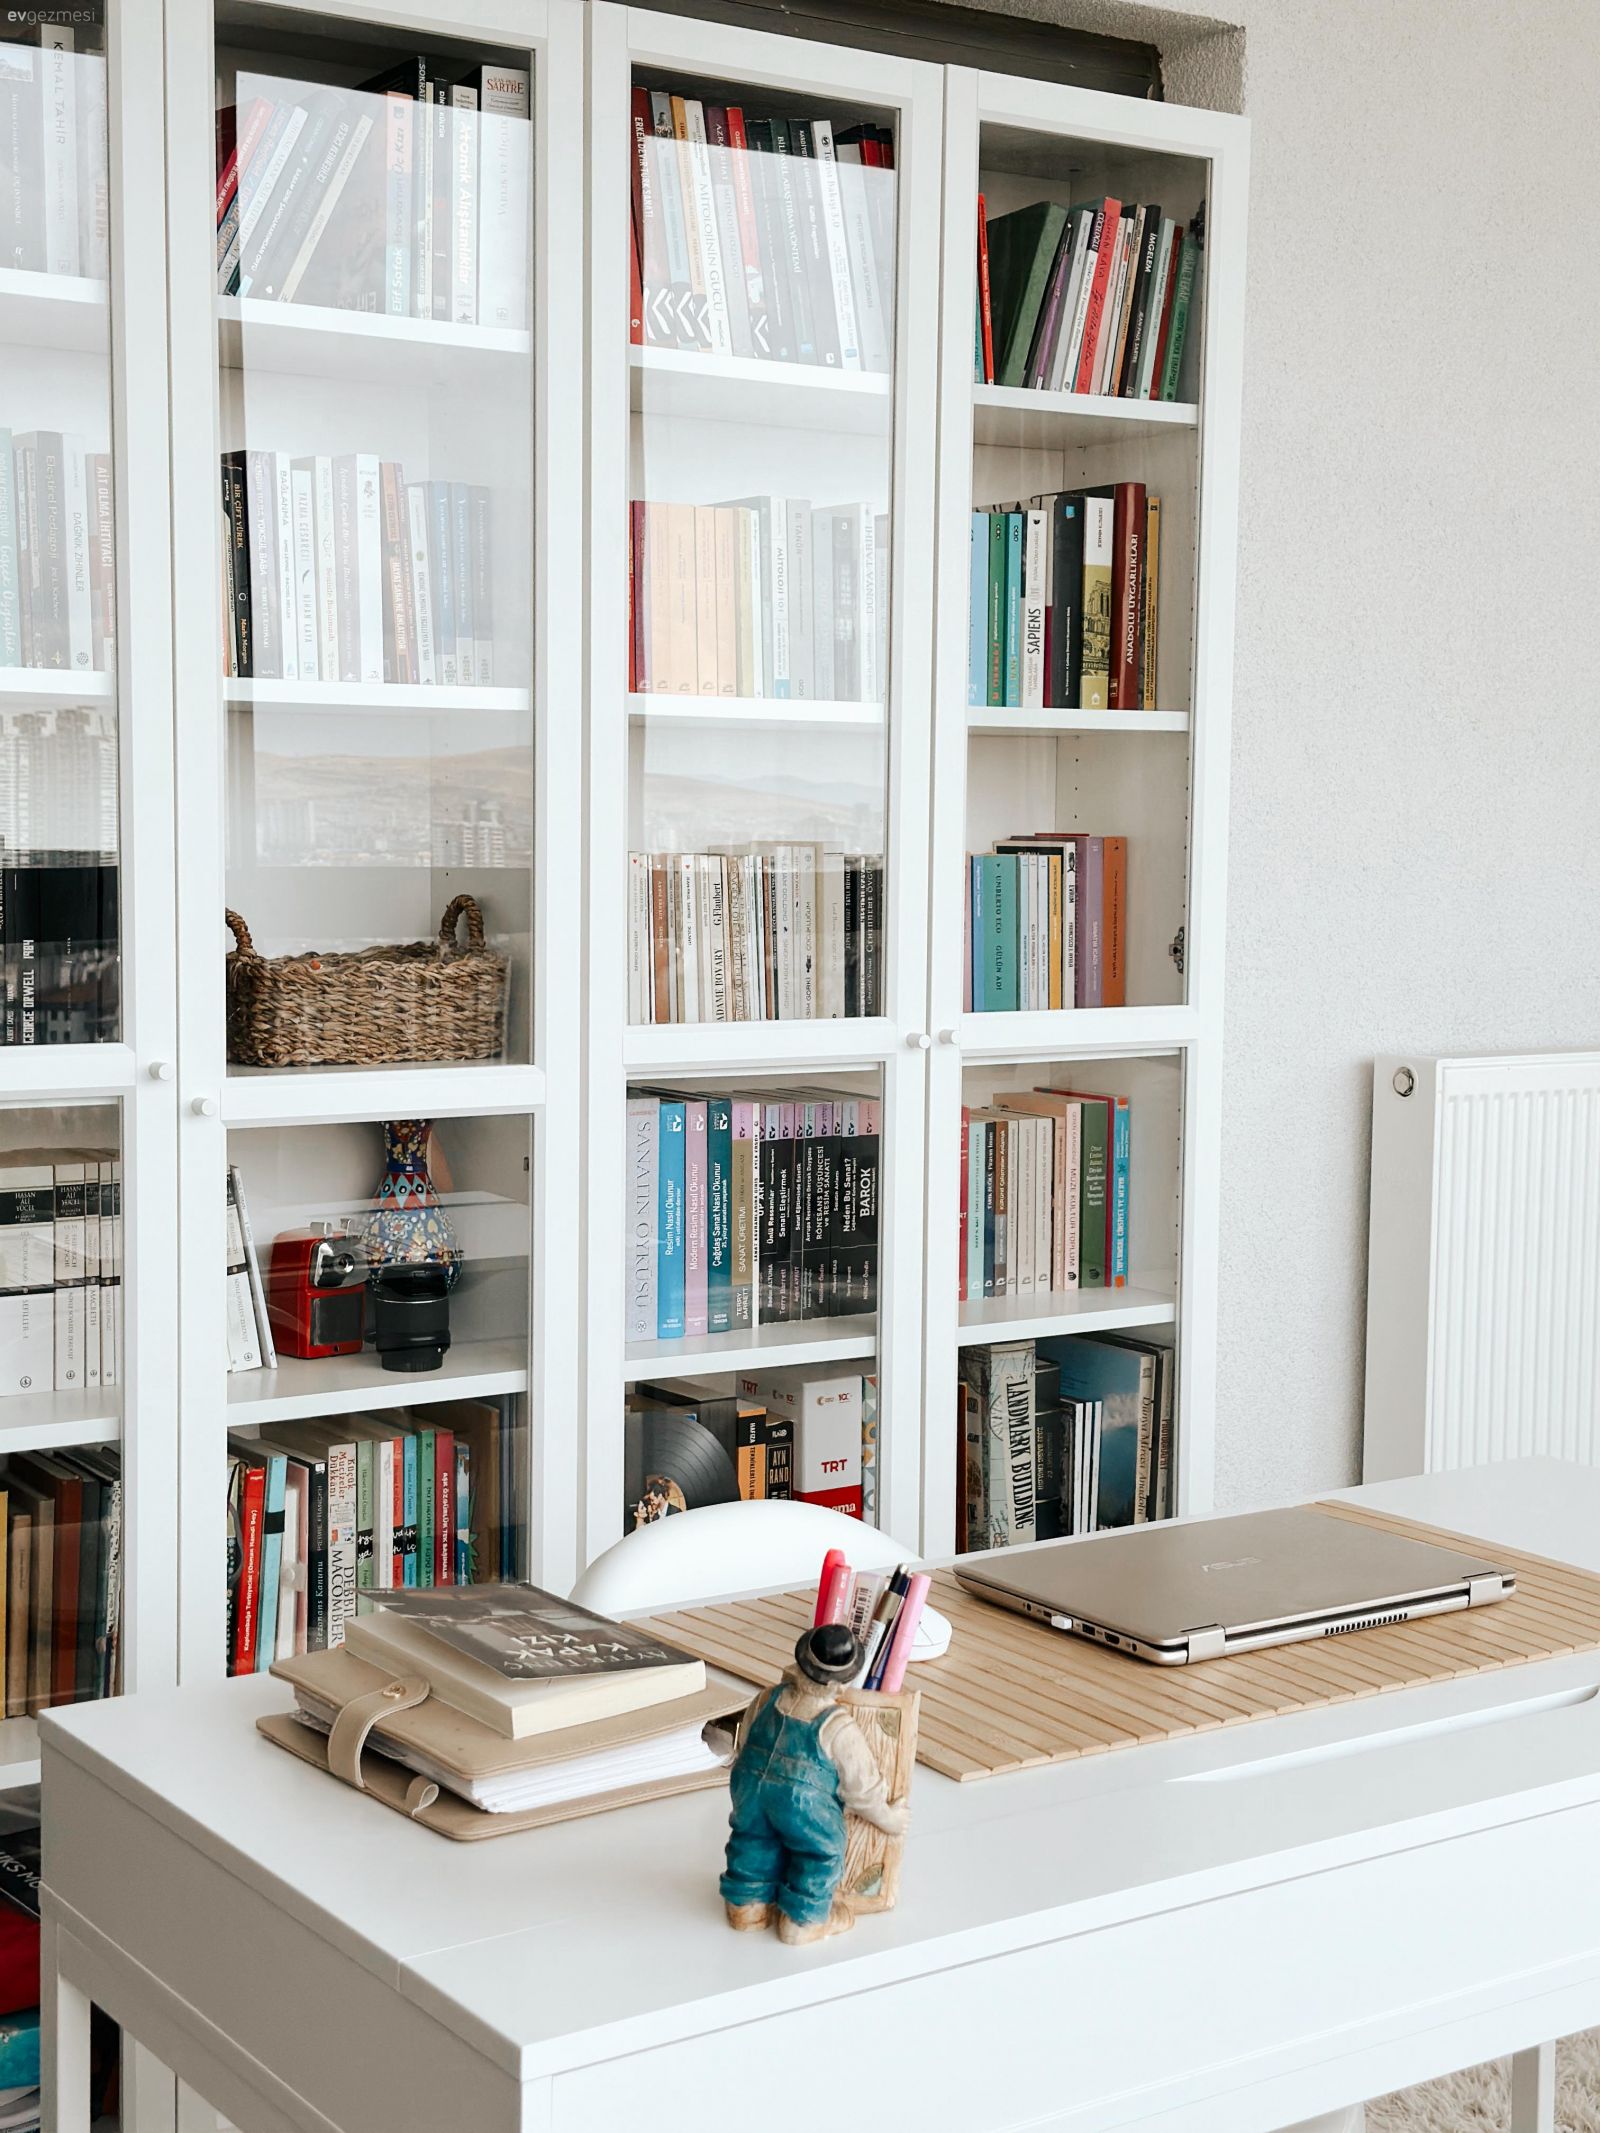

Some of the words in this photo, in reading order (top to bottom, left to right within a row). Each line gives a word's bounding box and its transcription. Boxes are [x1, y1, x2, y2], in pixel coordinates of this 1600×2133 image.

[53, 41, 65, 95] KEMAL
[633, 116, 647, 142] ERKEN
[714, 123, 725, 148] AZRA
[457, 121, 472, 182] Atomik
[457, 188, 473, 284] Alışkanlıklar
[700, 183, 718, 267] MİTOLOJİNİN
[1097, 251, 1111, 278] KAYA
[1144, 232, 1159, 274] İMGELEM
[45, 454, 57, 504] Eleştirel
[95, 466, 108, 485] AİT
[233, 483, 242, 498] BİR
[97, 487, 111, 518] OLMA
[233, 500, 243, 519] ÇİFT
[280, 470, 291, 527] BAĞLANMA
[47, 506, 59, 560] Pedagoji
[98, 520, 113, 568] İHTİYACI
[234, 521, 244, 550] YÜREK
[258, 552, 269, 577] BABA
[775, 547, 785, 594] MİTOLOJİ
[1127, 533, 1140, 609] UYGARLIKLARI
[863, 571, 875, 615] DÜNYA
[303, 623, 313, 643] KAYA
[1026, 608, 1042, 655] SAPIENS
[1125, 611, 1136, 664] ANADOLU
[711, 882, 724, 926] G.Flaubert
[994, 874, 1003, 915] UMBERTO
[866, 896, 875, 954] CEHENNEME
[994, 917, 1003, 934] ECO
[21, 939, 35, 960] 1984
[994, 944, 1005, 972] GÜLÜN
[712, 947, 725, 988] BOVARY
[21, 969, 35, 1008] ORWELL
[21, 1010, 35, 1044] GEORGE
[633, 1120, 654, 1217] SANATIN
[689, 1162, 700, 1193] Okunur
[712, 1162, 722, 1192] Okunur
[814, 1146, 825, 1195] DÜŞÜNCESİ
[823, 1158, 831, 1189] SANATI
[843, 1157, 852, 1189] Sanat?
[665, 1179, 675, 1210] Okunur
[689, 1193, 699, 1214] Nasıl
[712, 1192, 722, 1213] Nasıl
[778, 1168, 789, 1213] Eleştirmek
[821, 1190, 830, 1216] RESİM
[843, 1190, 851, 1204] Bu
[858, 1168, 870, 1217] BAROK
[665, 1210, 675, 1231] Nasıl
[766, 1189, 775, 1227] Ressamlar
[814, 1195, 824, 1241] RÖNESANS
[824, 1217, 830, 1228] ve
[843, 1205, 852, 1233] Neden
[689, 1214, 699, 1239] Resim
[712, 1213, 722, 1237] Sanat
[736, 1206, 747, 1243] ÜRETİMİ
[766, 1227, 775, 1245] Ünlü
[778, 1213, 787, 1238] Sanatı
[665, 1231, 674, 1256] Resim
[689, 1240, 699, 1270] Modern
[712, 1237, 723, 1267] Çağdaş
[738, 1243, 747, 1274] SANAT
[1069, 1231, 1077, 1267] TOPLUM
[633, 1221, 654, 1309] ÖYKÜSÜ
[735, 1292, 743, 1317] TERRY
[742, 1287, 750, 1321] BARRETT
[779, 1295, 787, 1316] Terry
[749, 1422, 757, 1444] HAFIZA
[1006, 1379, 1033, 1460] LANDMARK
[773, 1450, 787, 1467] AYN
[820, 1458, 849, 1474] TRT
[1140, 1433, 1150, 1470] Mirası
[329, 1455, 339, 1499] Dükkanı
[337, 1451, 347, 1500] Mucizeler
[347, 1458, 357, 1491] Küçük
[769, 1467, 790, 1484] RAND
[1011, 1463, 1035, 1530] BUILDING
[1137, 1472, 1148, 1517] Anadolu
[313, 1561, 323, 1597] Kanunu
[331, 1549, 345, 1644] MACOMBER
[243, 1611, 252, 1652] Kaplumbağa
[313, 1600, 323, 1644] Rezonans
[505, 1641, 630, 1661] KAPAK
[508, 1632, 582, 1646] KIZI
